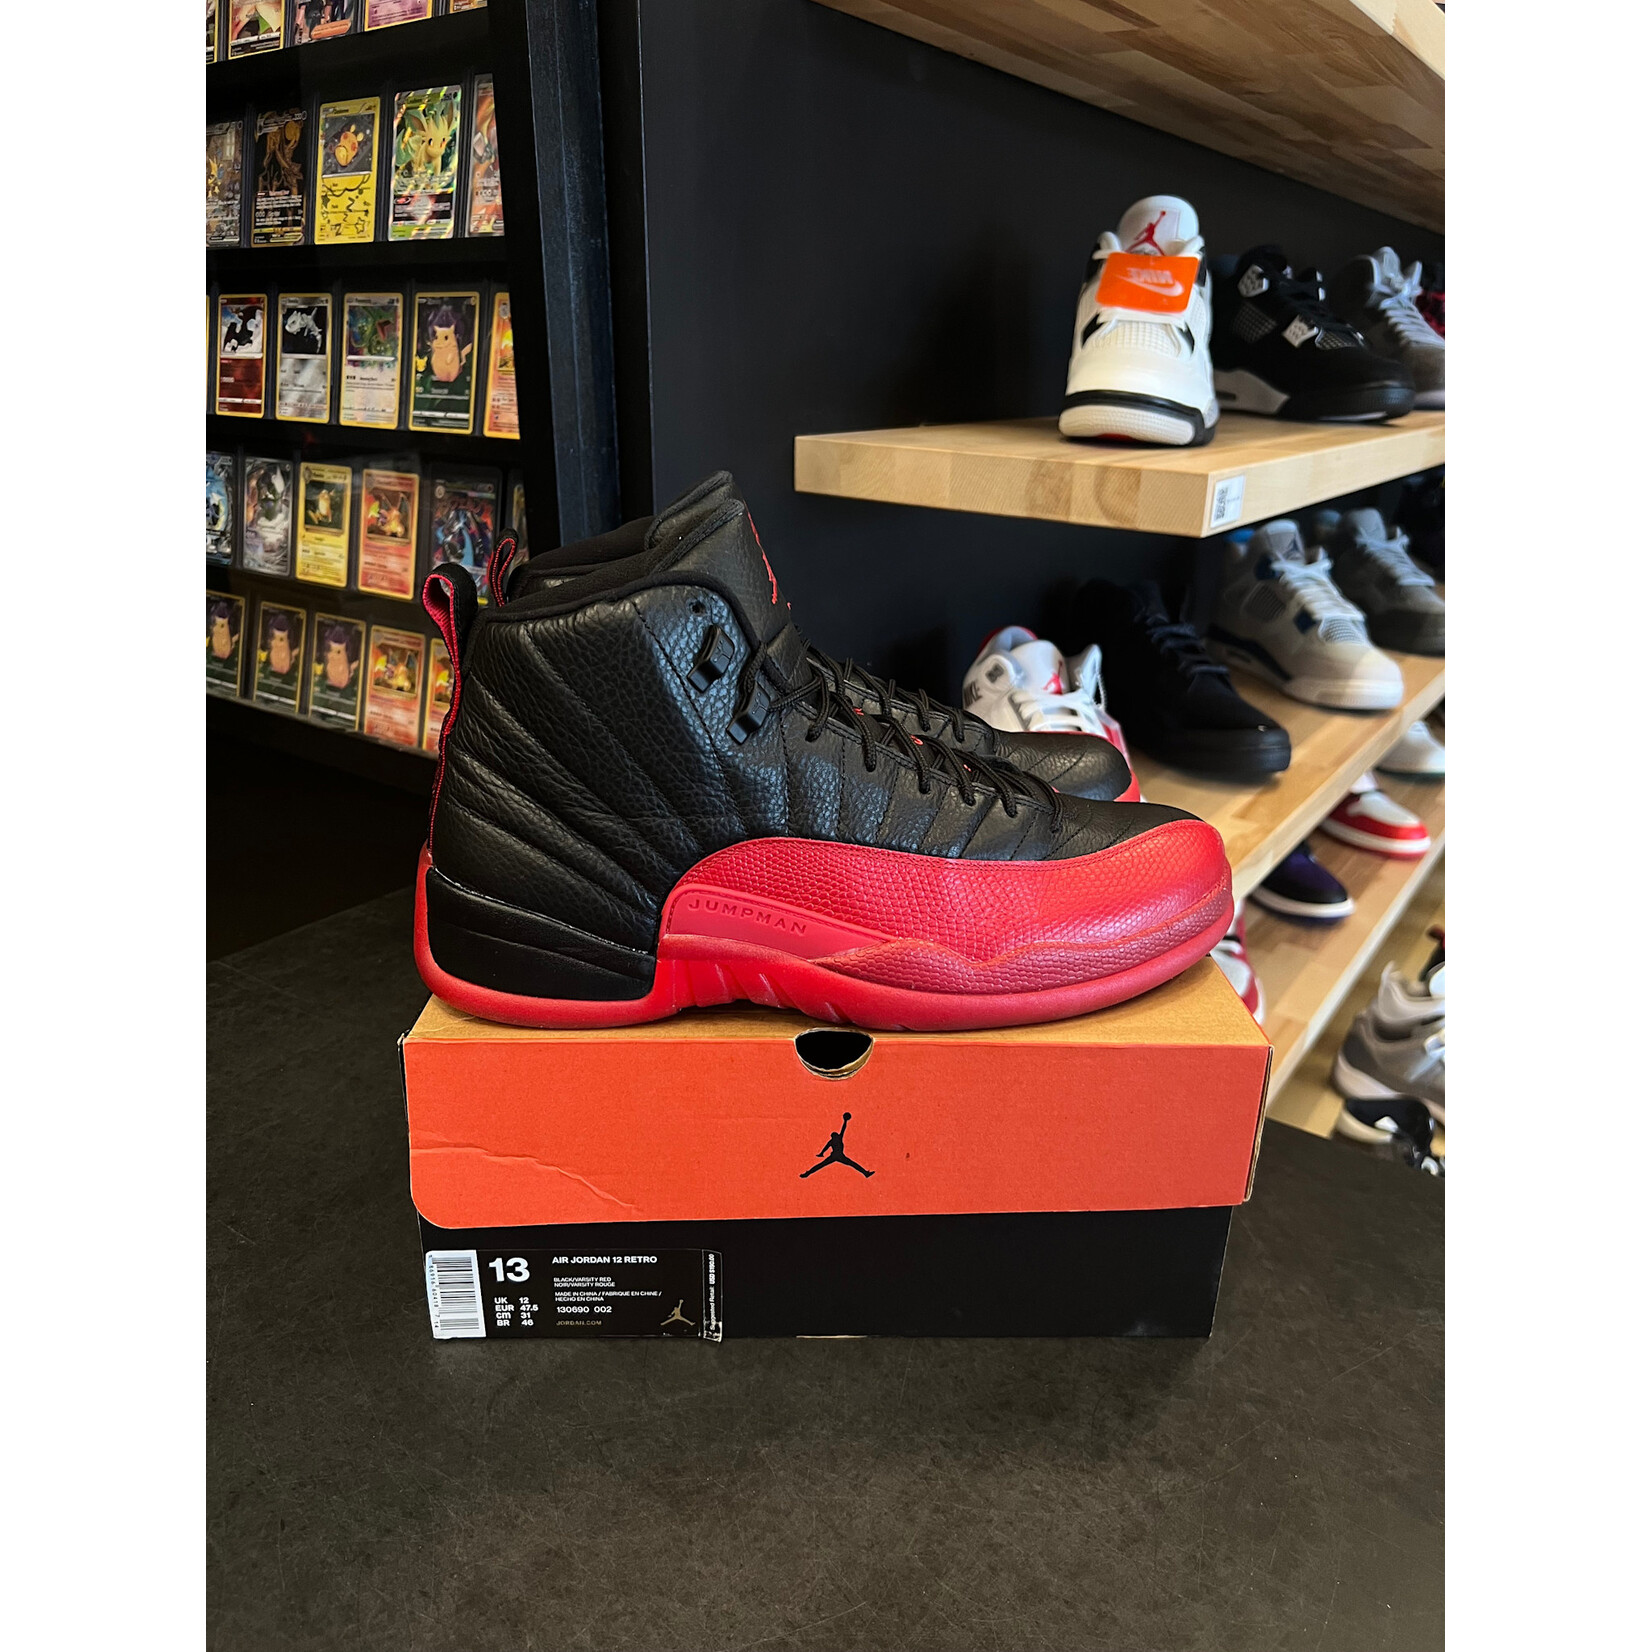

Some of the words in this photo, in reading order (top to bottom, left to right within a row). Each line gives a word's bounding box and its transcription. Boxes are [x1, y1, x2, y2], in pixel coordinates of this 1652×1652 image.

[688, 899, 807, 935] JUMPMAN
[552, 1256, 569, 1264] AIR
[570, 1256, 611, 1264] JORDAN
[612, 1256, 623, 1264] 12
[488, 1257, 530, 1283] 13
[495, 1304, 515, 1312] EUR
[593, 1305, 613, 1313] 002
[496, 1319, 511, 1327] BR
